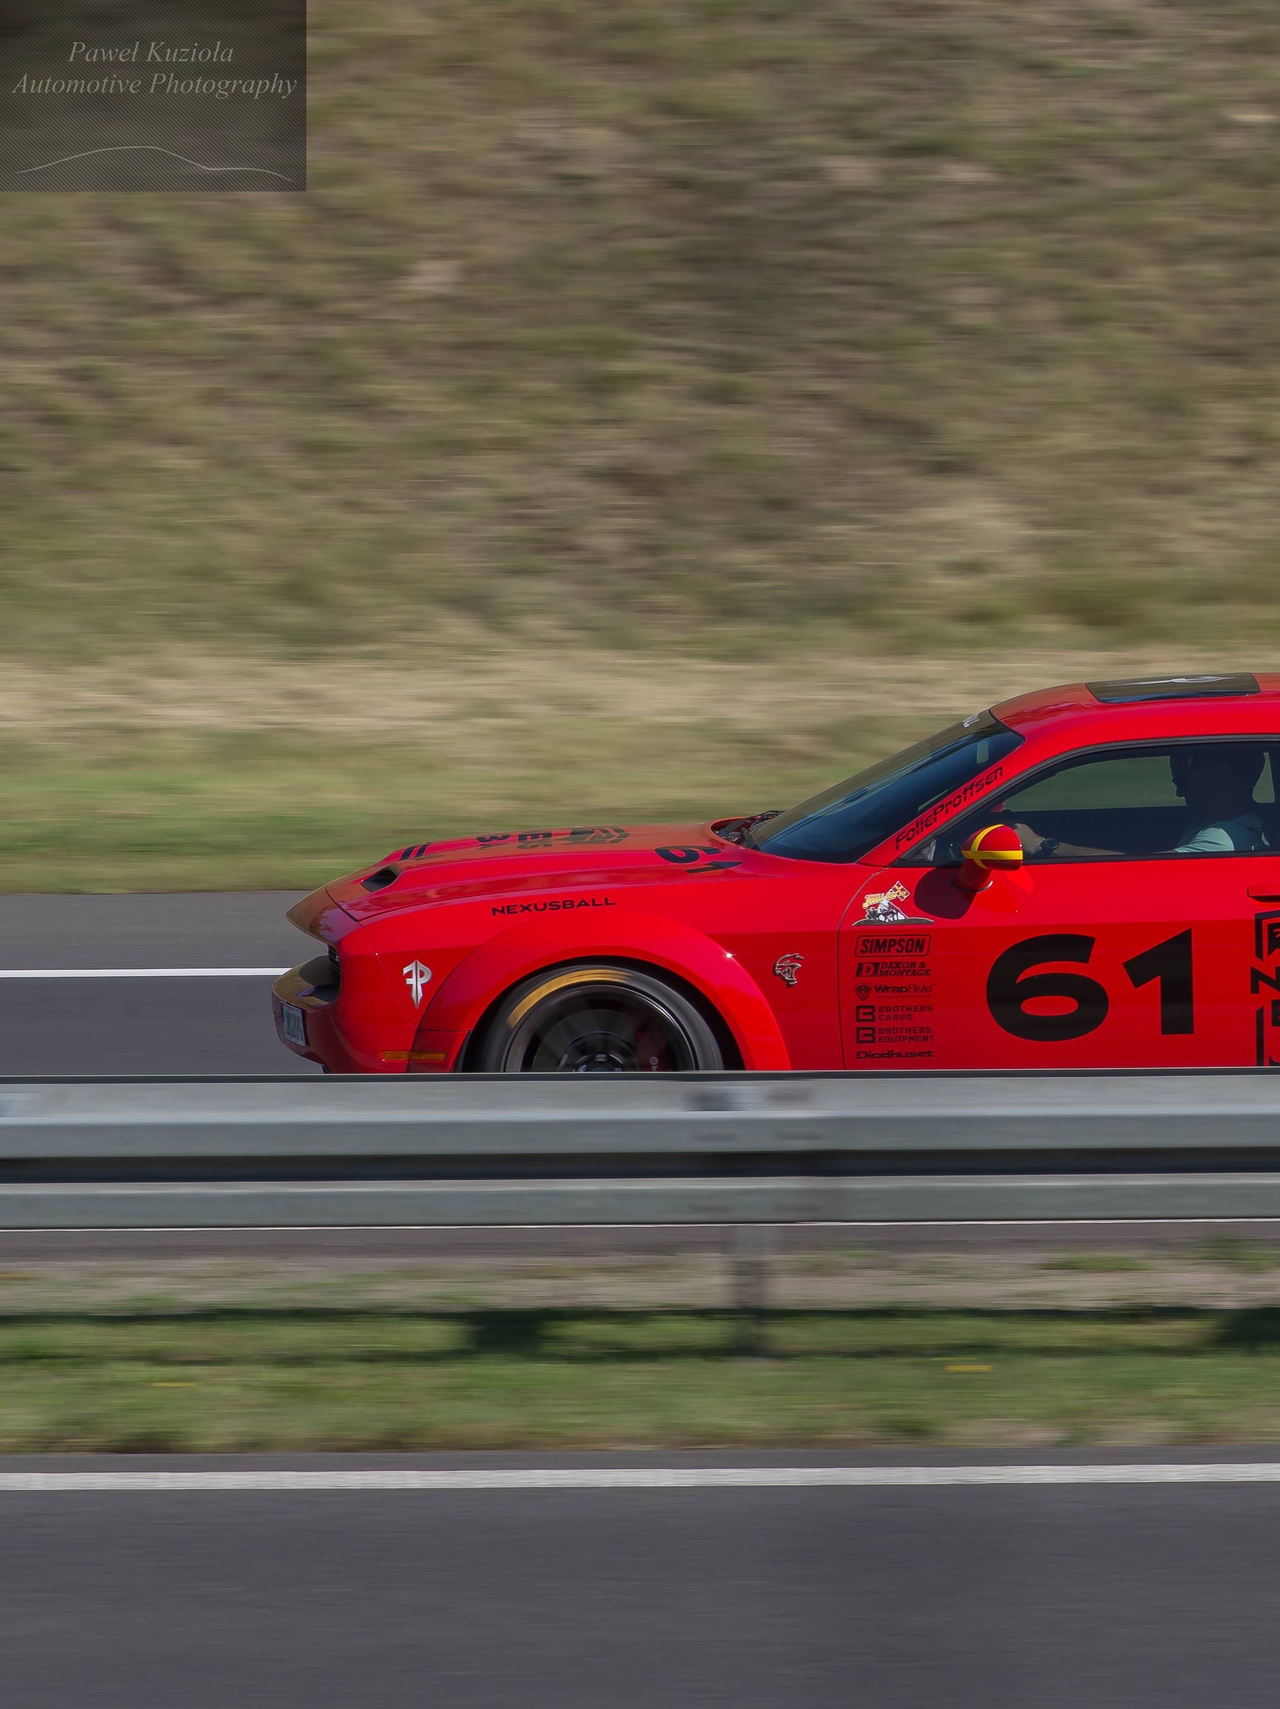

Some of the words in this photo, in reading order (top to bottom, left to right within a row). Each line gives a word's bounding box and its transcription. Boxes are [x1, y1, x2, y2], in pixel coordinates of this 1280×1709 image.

[492, 897, 616, 916] NEXUSBALL
[860, 938, 926, 954] SIMPSON
[880, 961, 917, 969] DEKOR
[918, 961, 926, 969] &
[878, 969, 932, 977] MONTAGE
[986, 927, 1195, 1042] 61
[878, 1013, 912, 1021] CARGO
[878, 1034, 935, 1043] EQUIPMENT
[856, 1049, 935, 1060] Diodhuset
